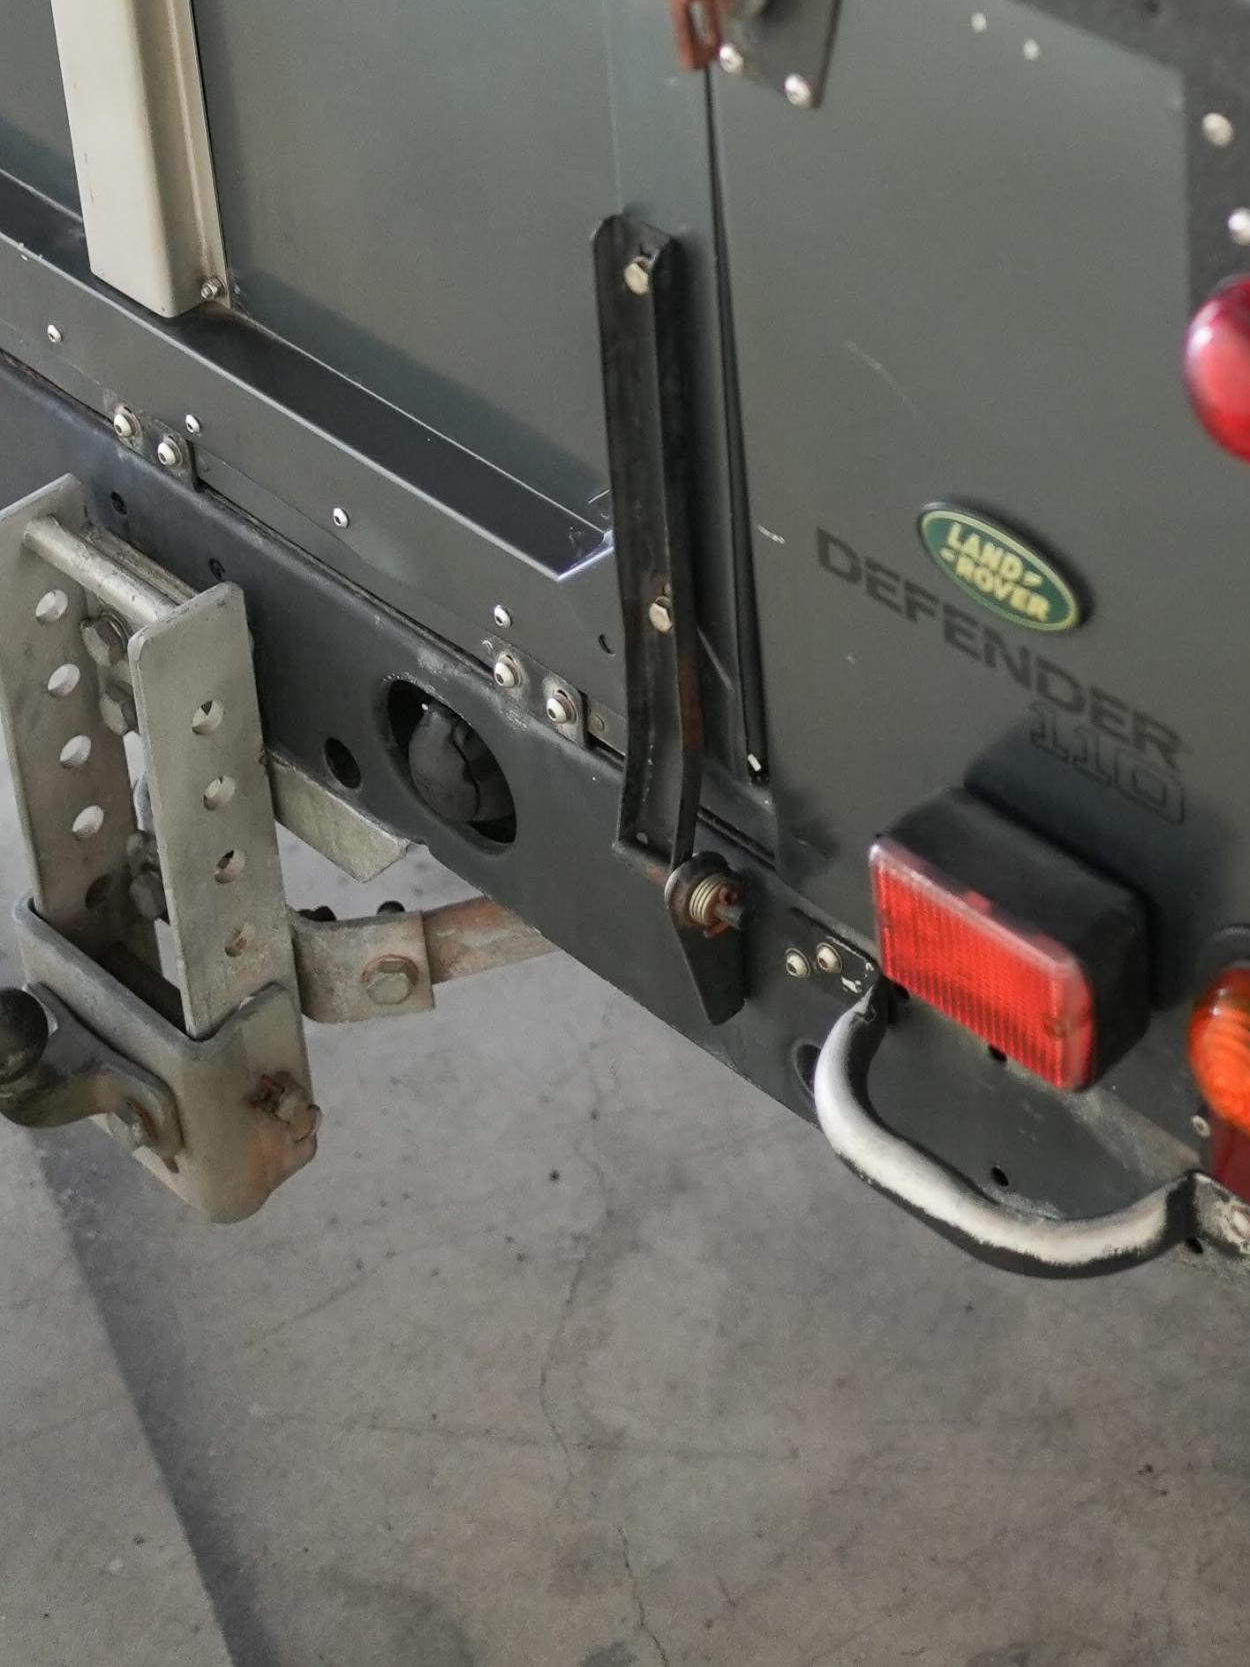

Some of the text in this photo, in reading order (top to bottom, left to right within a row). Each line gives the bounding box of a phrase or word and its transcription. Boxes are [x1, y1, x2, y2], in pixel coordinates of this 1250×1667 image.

[947, 521, 1024, 582] LAND
[955, 554, 1050, 622] ROVER
[816, 526, 1188, 772] DEFENDER
[1025, 700, 1186, 825] 110
